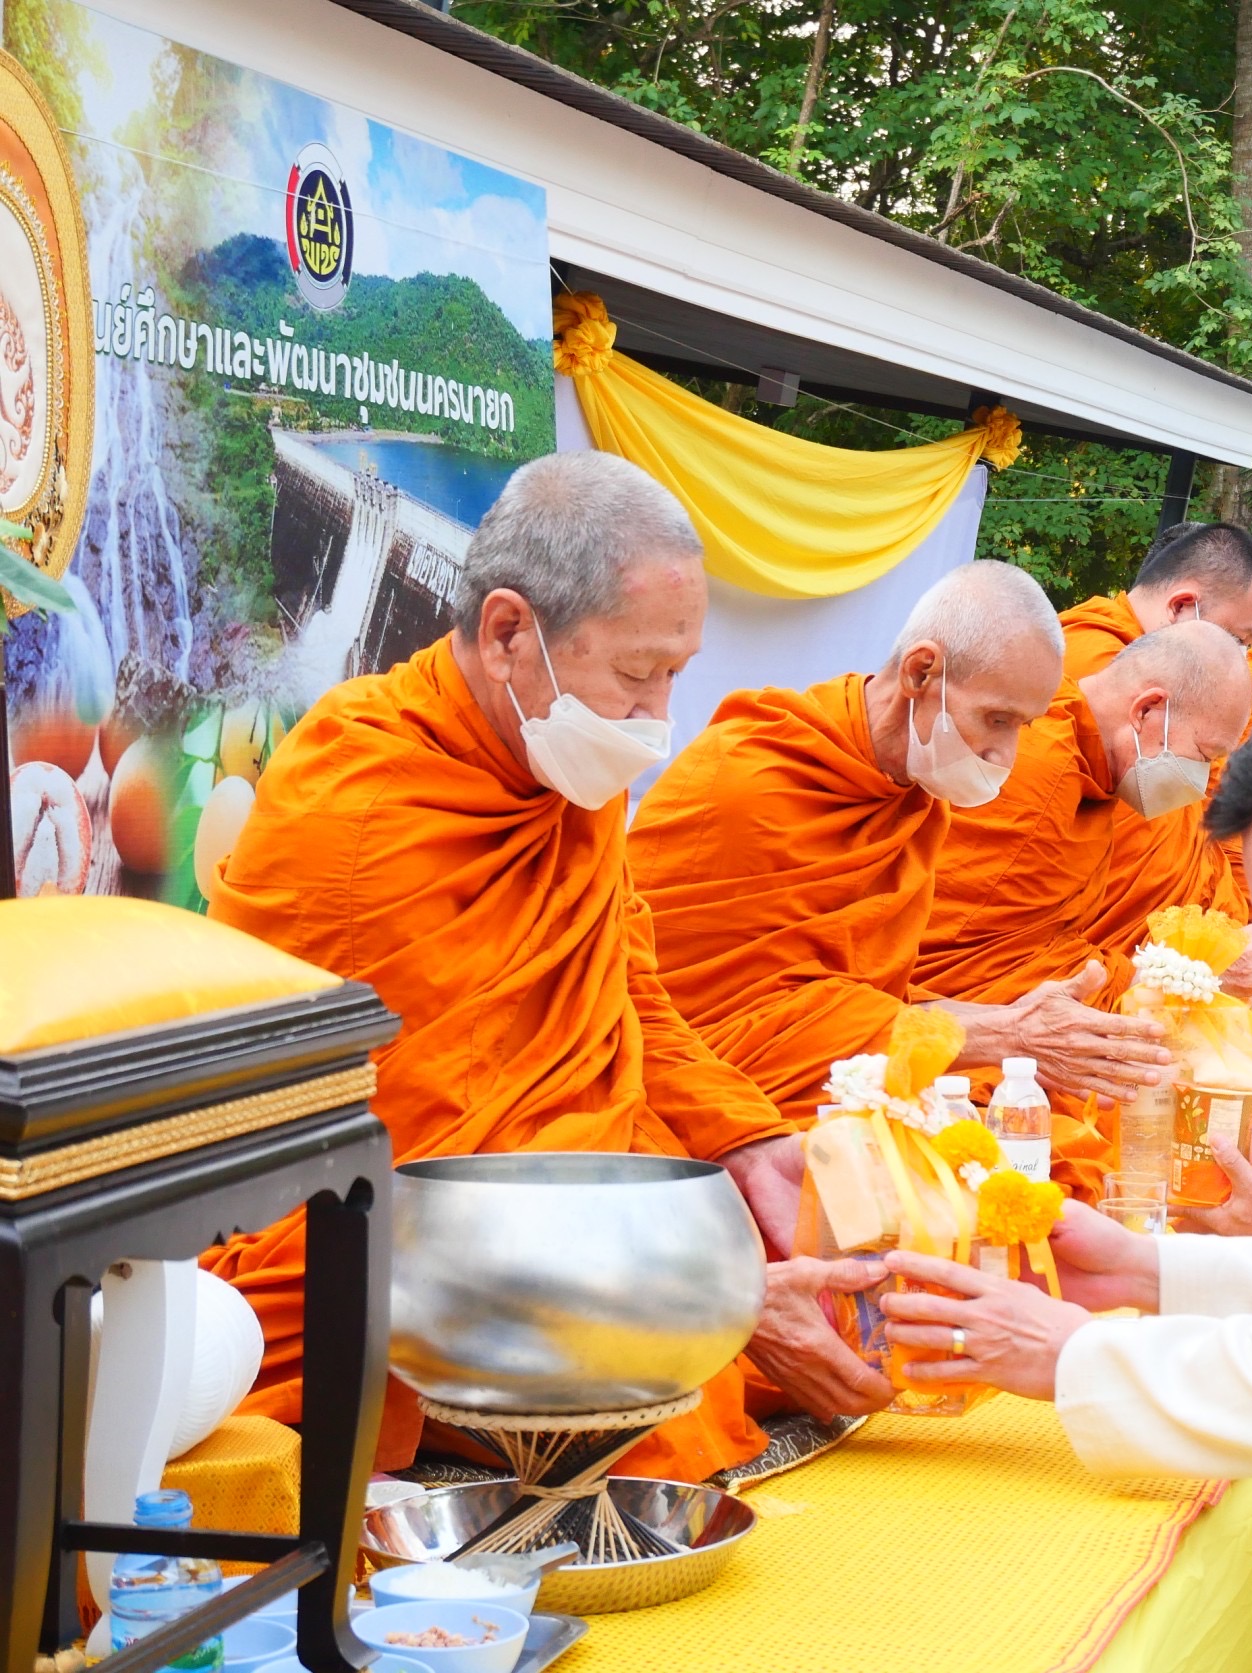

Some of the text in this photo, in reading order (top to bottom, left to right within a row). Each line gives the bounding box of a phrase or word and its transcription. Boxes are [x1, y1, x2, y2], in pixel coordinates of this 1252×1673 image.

[92, 282, 515, 433] นย์ศึกษาและพัฒนาชุมชนนครนายก
